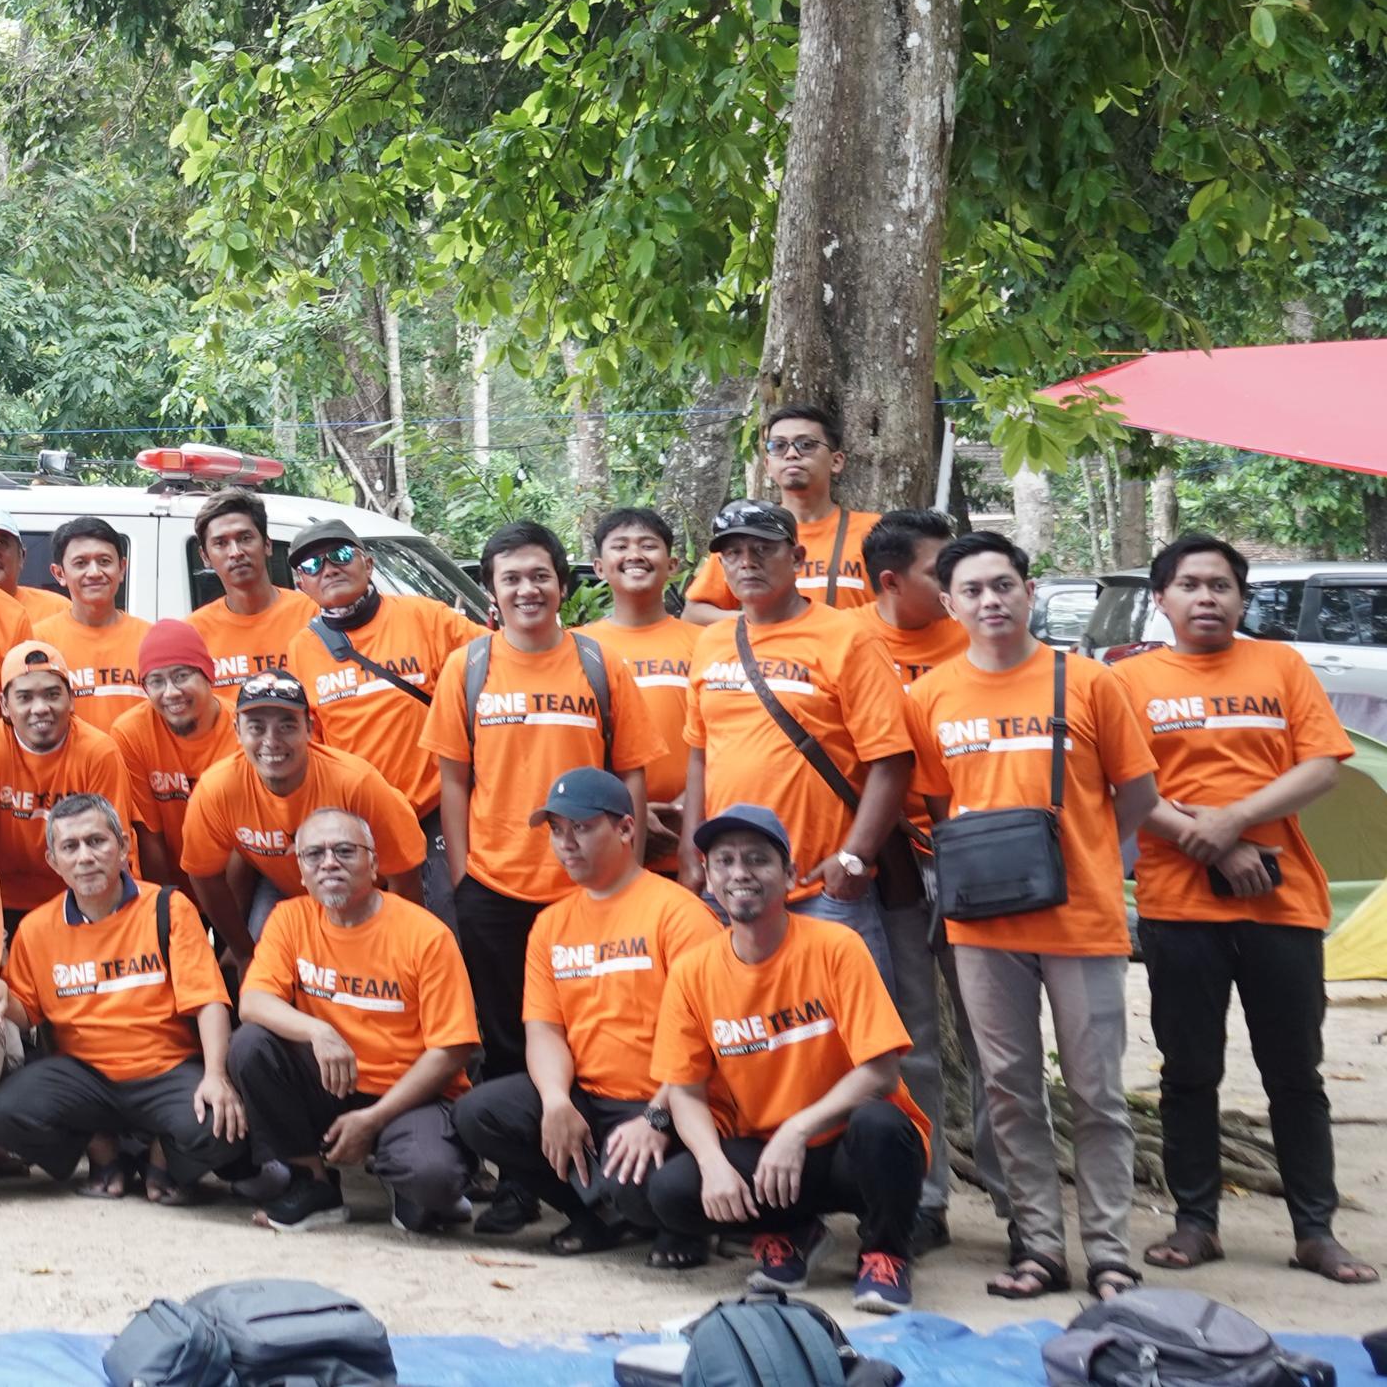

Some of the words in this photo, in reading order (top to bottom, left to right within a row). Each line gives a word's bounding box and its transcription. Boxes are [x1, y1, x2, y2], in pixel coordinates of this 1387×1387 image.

[68, 667, 96, 687] NE
[98, 668, 140, 685] TEA
[316, 667, 359, 697] ONE
[476, 692, 527, 717] ONE
[531, 693, 597, 716] TEAM
[1146, 695, 1206, 723] ONE
[1211, 696, 1283, 717] TEAM
[938, 717, 990, 747] ONE
[149, 769, 189, 792] ONE
[235, 826, 285, 849] ONE
[551, 943, 596, 970] ONE
[598, 936, 649, 960] TEAM
[52, 960, 97, 988] ONE
[101, 952, 163, 982] TEAM
[296, 957, 337, 991] ONE
[339, 975, 401, 1000] TEAM
[712, 1014, 768, 1046] ONE
